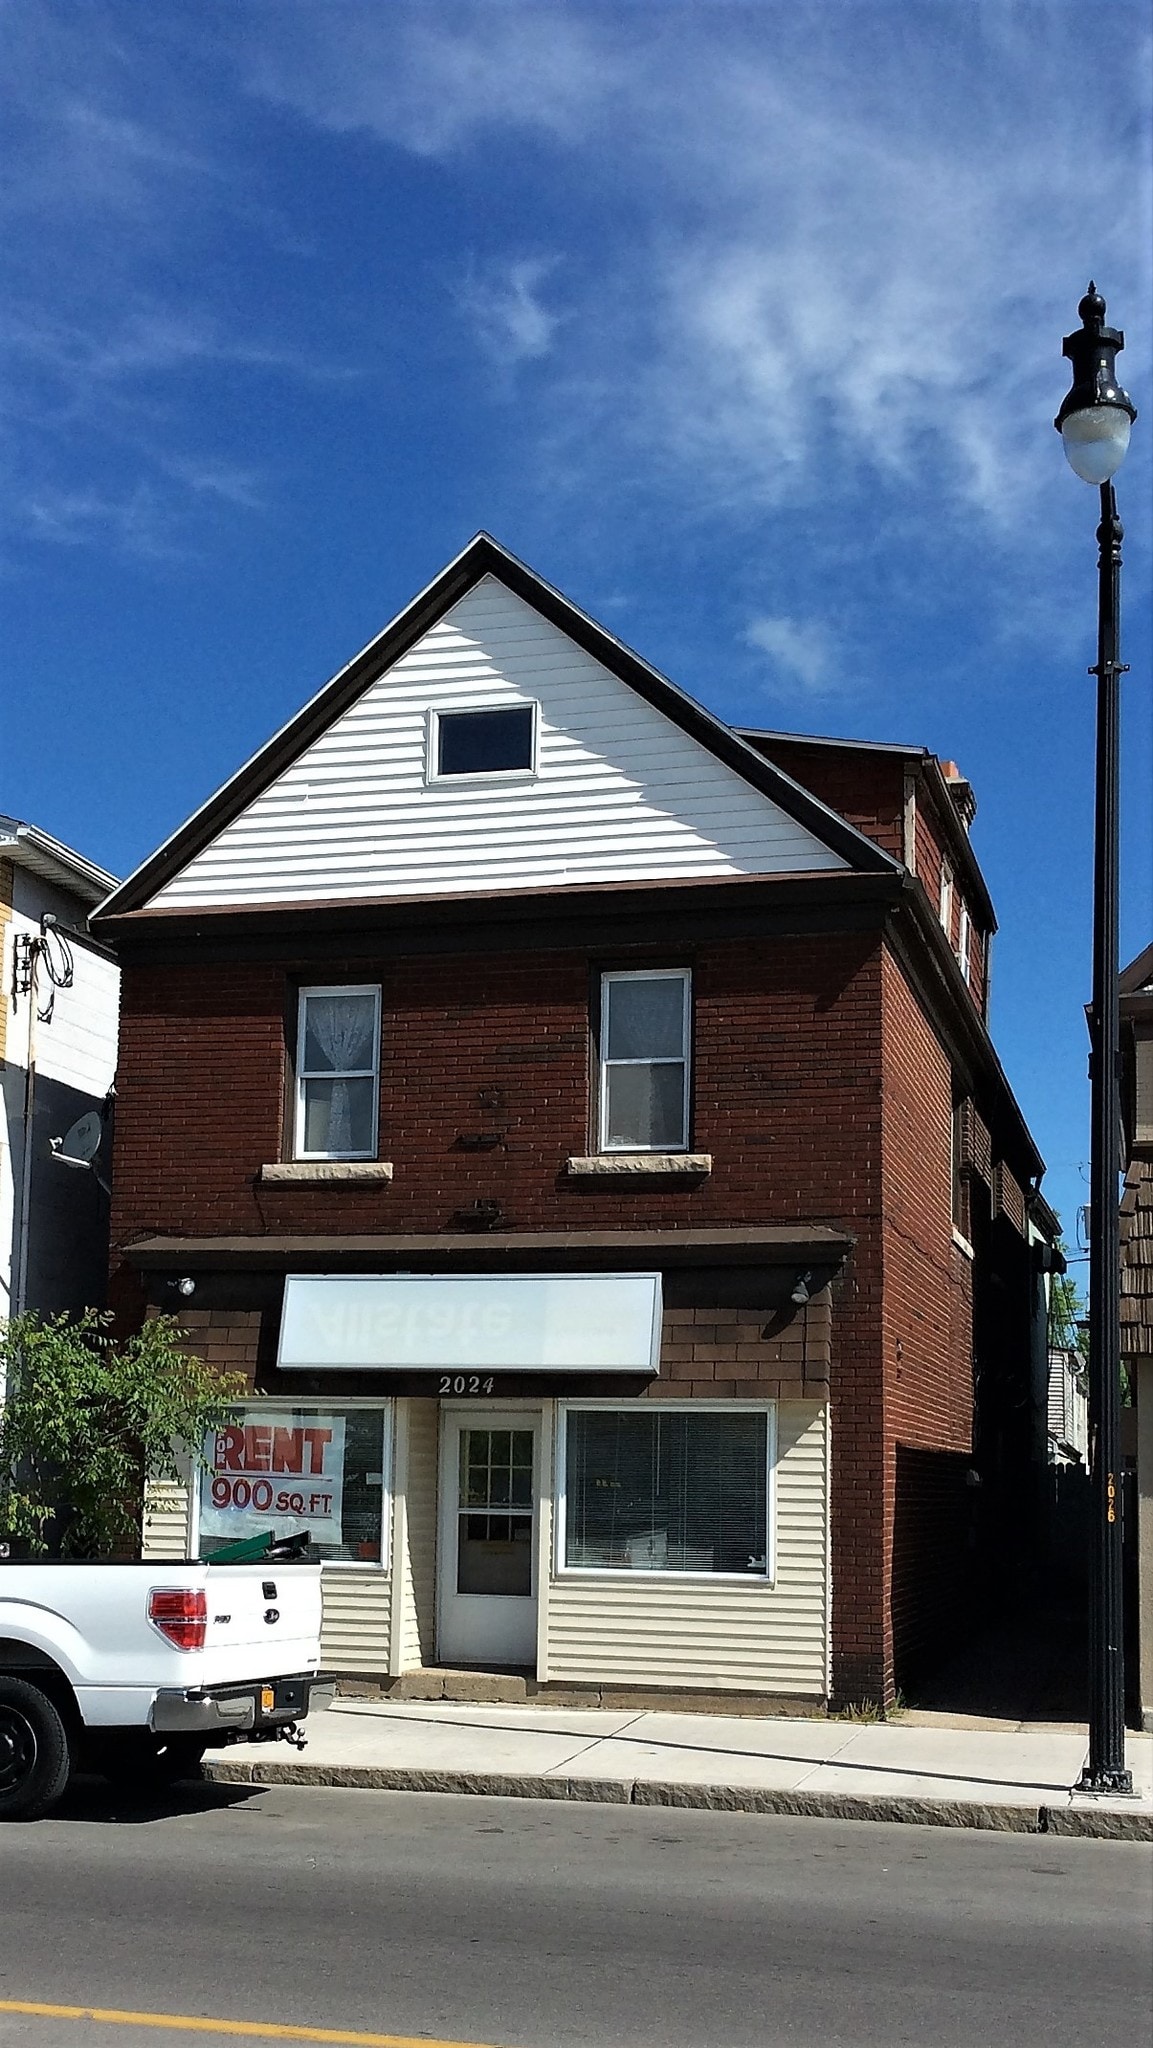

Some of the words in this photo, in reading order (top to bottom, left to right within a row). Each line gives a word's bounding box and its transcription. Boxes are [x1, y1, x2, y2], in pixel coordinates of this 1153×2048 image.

[439, 1375, 495, 1394] 2024
[214, 1424, 333, 1474] RENT
[211, 1477, 274, 1511] 900
[275, 1491, 306, 1514] SQ.
[309, 1493, 333, 1514] FT.
[1107, 1473, 1116, 1523] 2026
